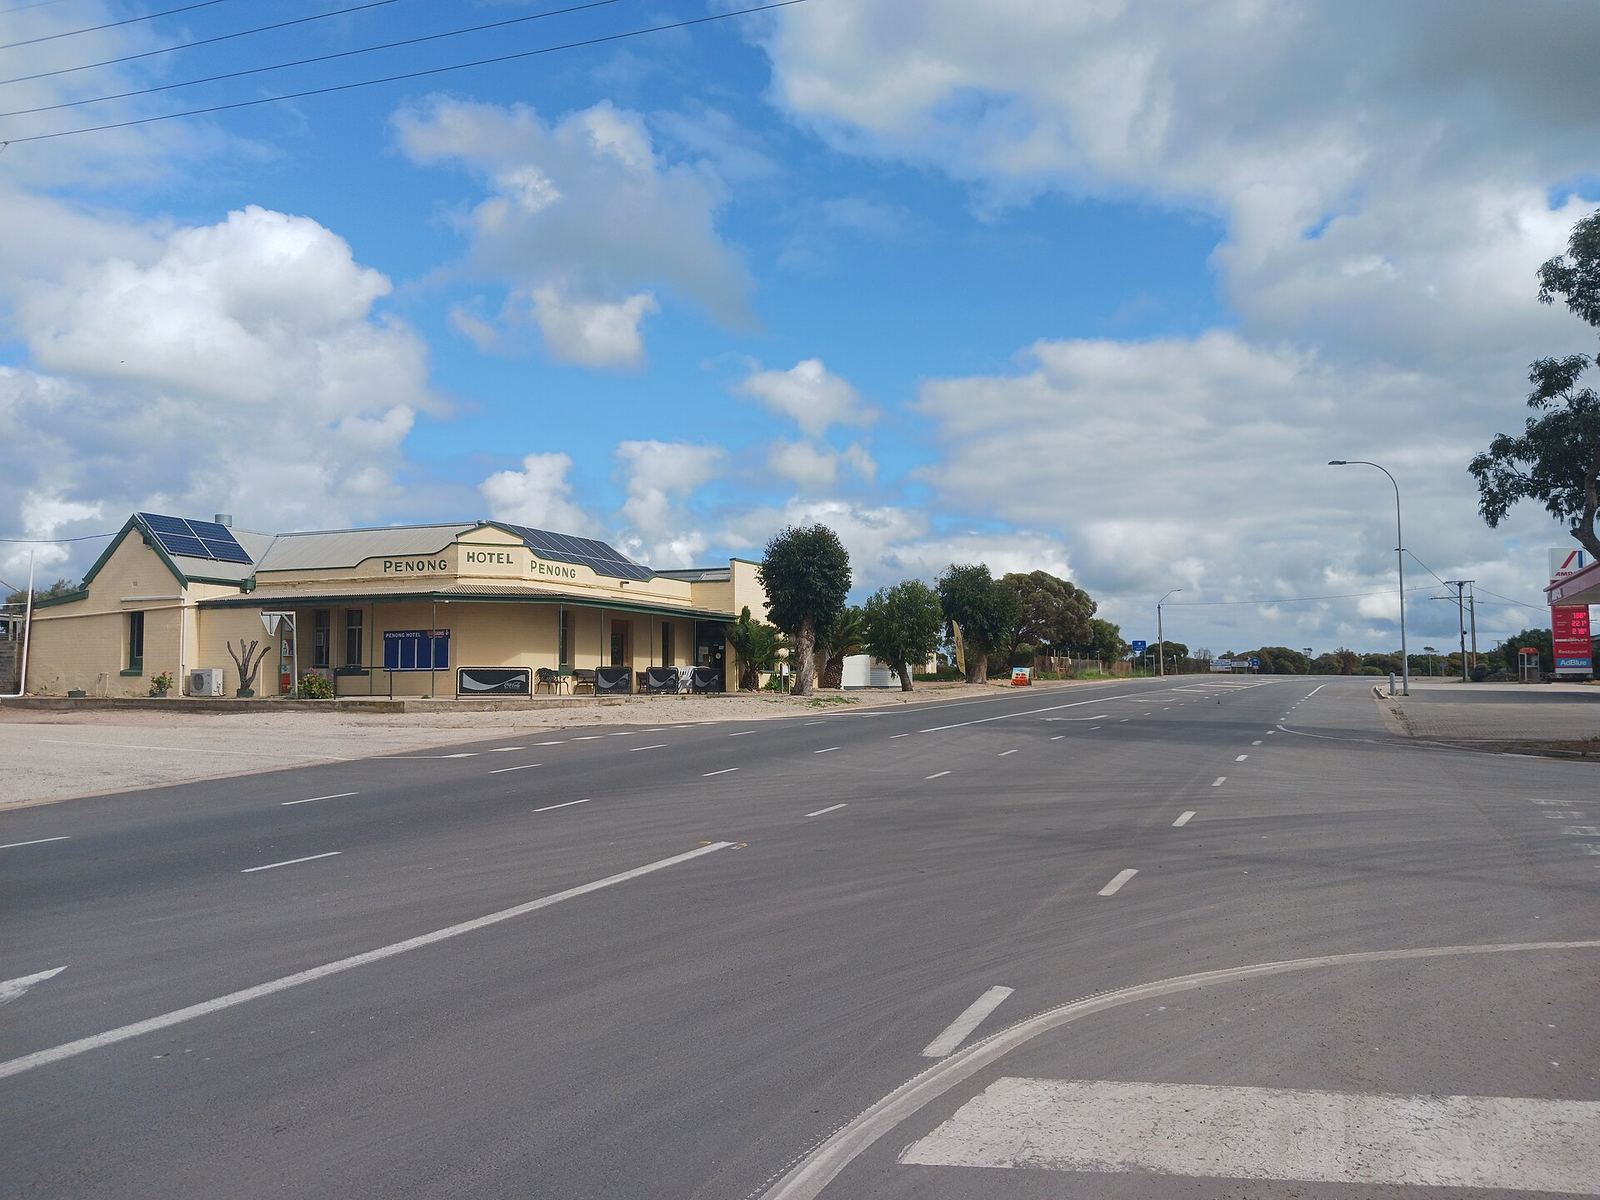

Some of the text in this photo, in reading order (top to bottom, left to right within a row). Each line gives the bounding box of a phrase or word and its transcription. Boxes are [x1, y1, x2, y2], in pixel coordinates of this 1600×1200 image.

[466, 551, 514, 564] HOTEL
[383, 559, 448, 573] PENONG
[530, 560, 577, 579] PENONG
